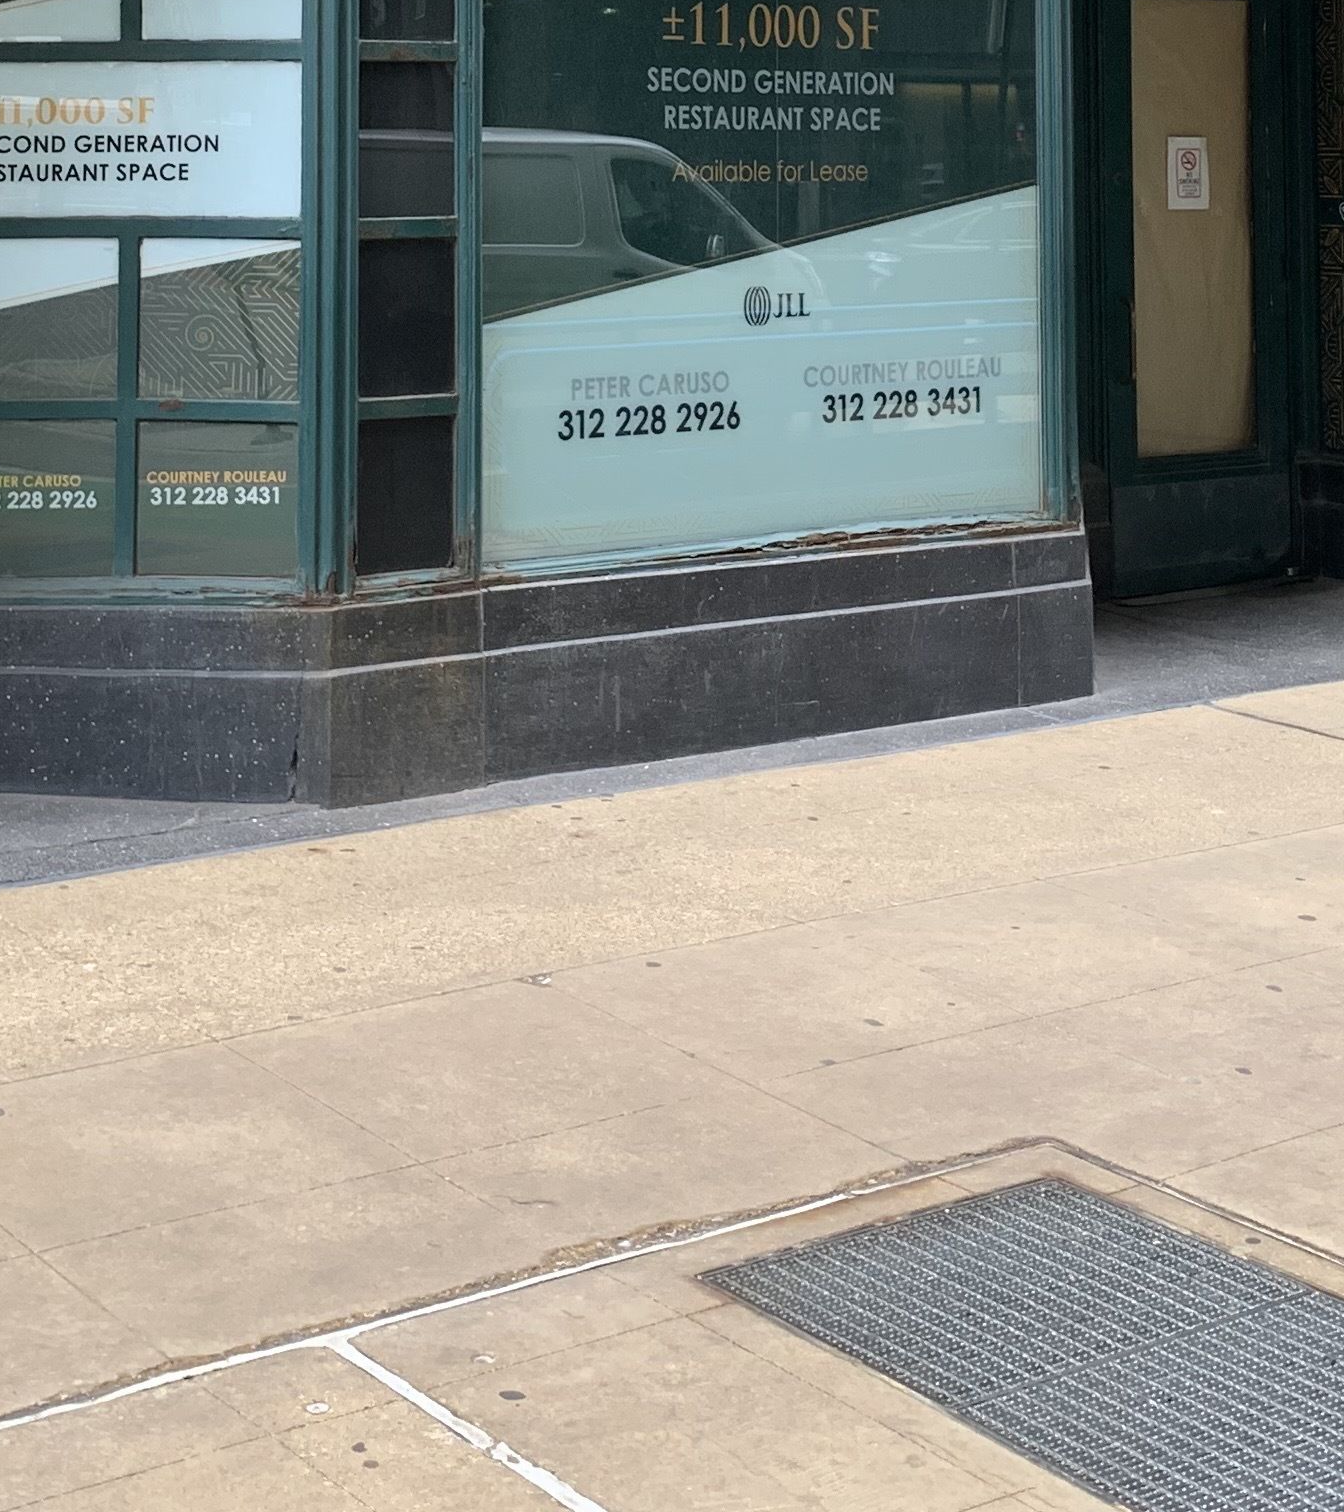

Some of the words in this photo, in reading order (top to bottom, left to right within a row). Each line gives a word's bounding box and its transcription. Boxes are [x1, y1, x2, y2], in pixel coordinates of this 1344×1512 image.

[662, 1, 821, 53] ±11,000
[836, 6, 879, 50] SF
[647, 67, 746, 93] SECOND
[754, 69, 894, 95] GENERATION
[116, 96, 155, 125] SF
[664, 105, 803, 131] RESTAURANT
[810, 107, 881, 131] SPACE
[74, 134, 219, 153] GENERATION
[116, 163, 189, 181] SPACE
[672, 159, 770, 182] Available
[777, 159, 805, 182] for
[810, 160, 868, 183] Lease
[773, 292, 811, 318] JLL
[803, 361, 908, 387] COURTNEY
[916, 356, 1001, 381] ROULEAU
[571, 376, 631, 401] PETER
[638, 371, 729, 397] CARUSO
[822, 392, 864, 423] 312
[872, 389, 918, 419] 228
[927, 386, 981, 416] 3431
[558, 408, 605, 441] 312
[615, 404, 666, 437] 228
[676, 400, 741, 432] 2926
[22, 474, 82, 487] CARUSO
[146, 471, 219, 484] COURTNEY
[223, 470, 287, 483] ROULEAU
[7, 491, 43, 509] 228
[49, 490, 97, 509] 2926
[150, 487, 186, 505] 312
[191, 486, 229, 505] 228
[234, 486, 280, 505] 3431
